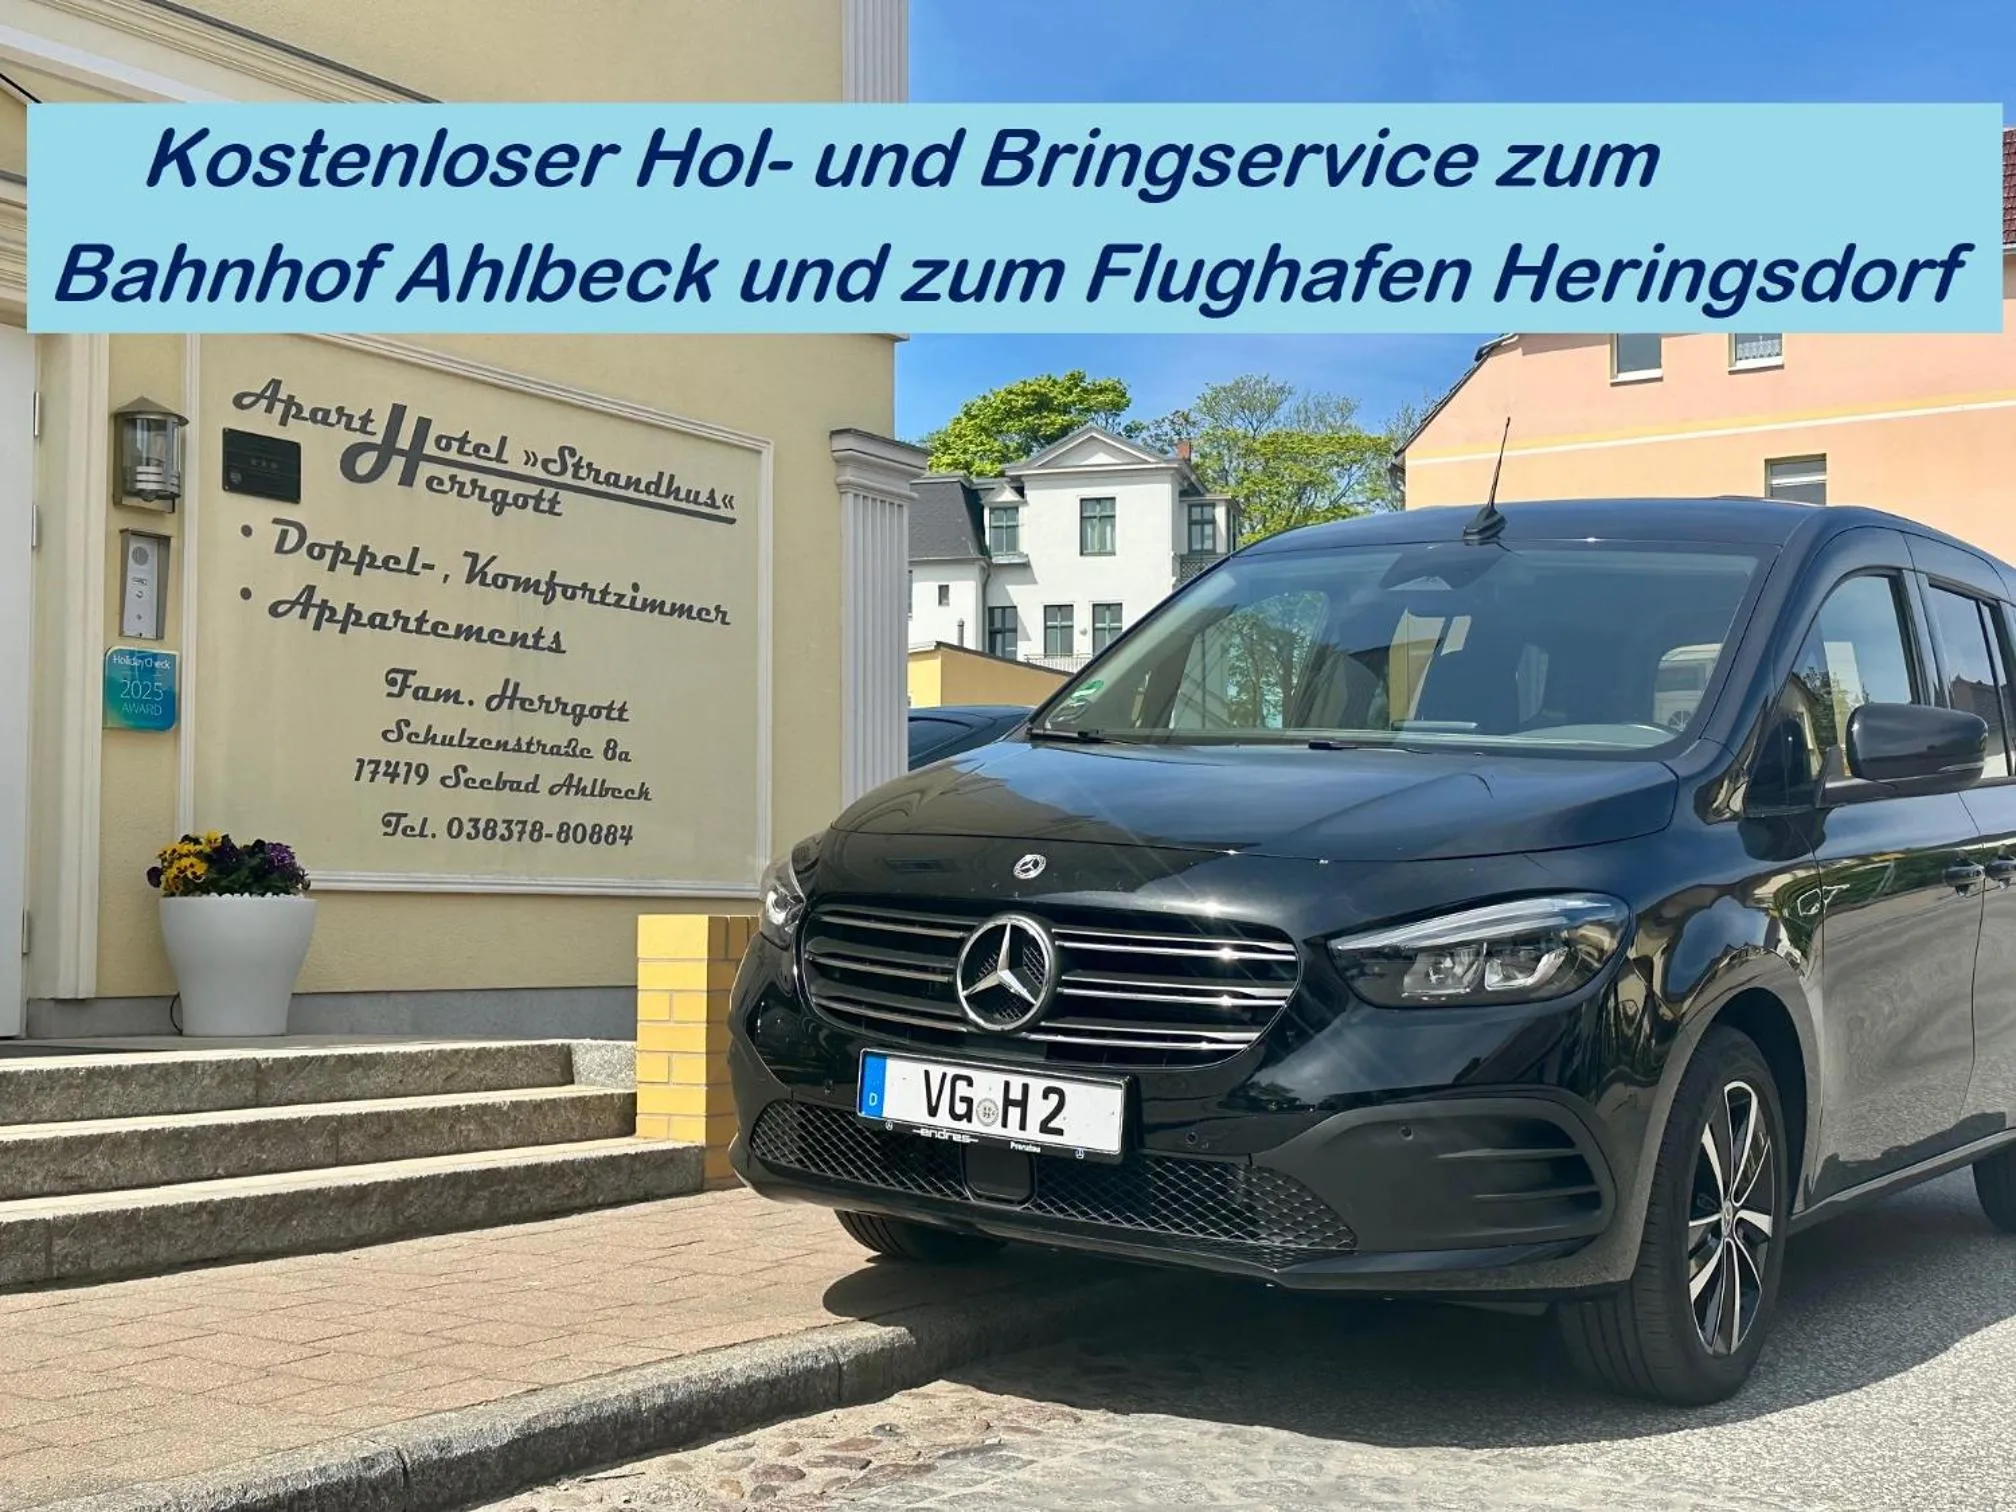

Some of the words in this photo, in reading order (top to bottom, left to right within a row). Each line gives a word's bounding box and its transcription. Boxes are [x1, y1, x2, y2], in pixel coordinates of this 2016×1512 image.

[232, 378, 376, 436] Apart
[463, 550, 731, 626] Komfortzimmer
[268, 584, 566, 654] Appartements
[120, 679, 164, 701] 2025
[121, 702, 163, 716] AWARD
[385, 667, 475, 707] Fam.
[485, 678, 630, 726] Herrgott
[381, 719, 594, 760] Schulzenstraße
[603, 738, 632, 763] 8a
[354, 758, 429, 785] 17419
[440, 765, 541, 794] Seebad
[548, 773, 652, 801] Ahlbeck
[382, 812, 437, 839] Tel.
[446, 816, 634, 846] 038378-80884
[868, 1091, 878, 1107] D
[924, 1069, 974, 1124] VG
[1001, 1080, 1029, 1131] H
[1039, 1085, 1066, 1137] 2
